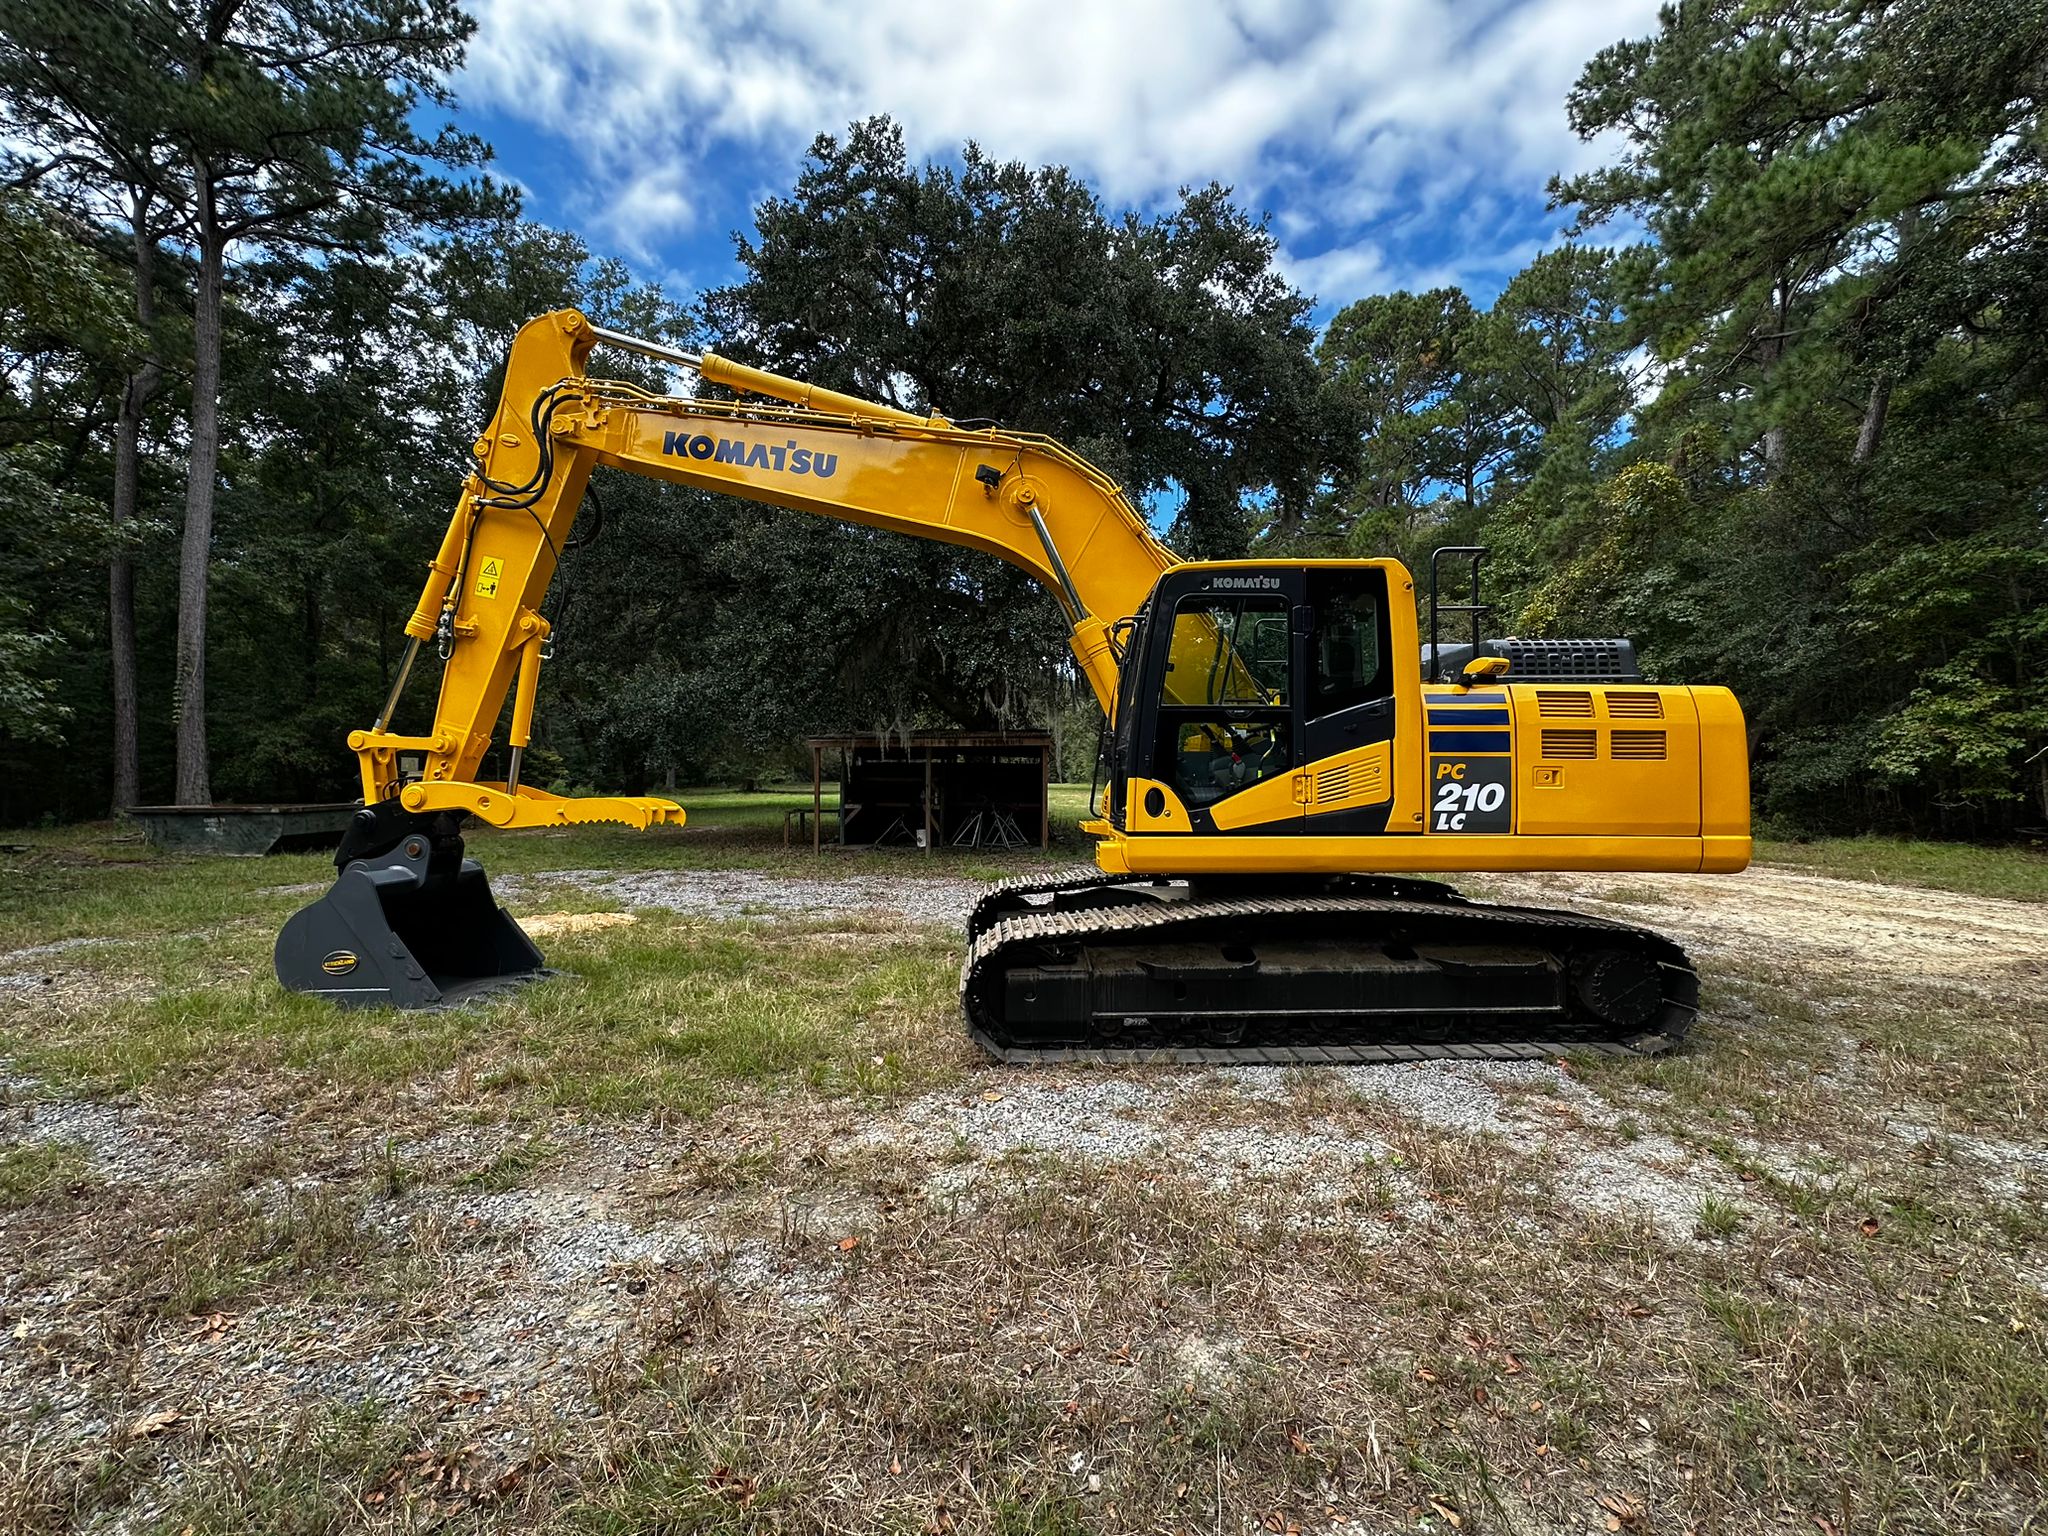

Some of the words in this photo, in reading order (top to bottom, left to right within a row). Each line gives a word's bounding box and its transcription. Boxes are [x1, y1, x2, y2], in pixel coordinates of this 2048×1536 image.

[662, 430, 838, 478] KOMATSU
[1213, 575, 1280, 589] KOMATSU
[1436, 763, 1467, 780] PC
[1433, 782, 1506, 812] 210
[1435, 812, 1467, 831] LC
